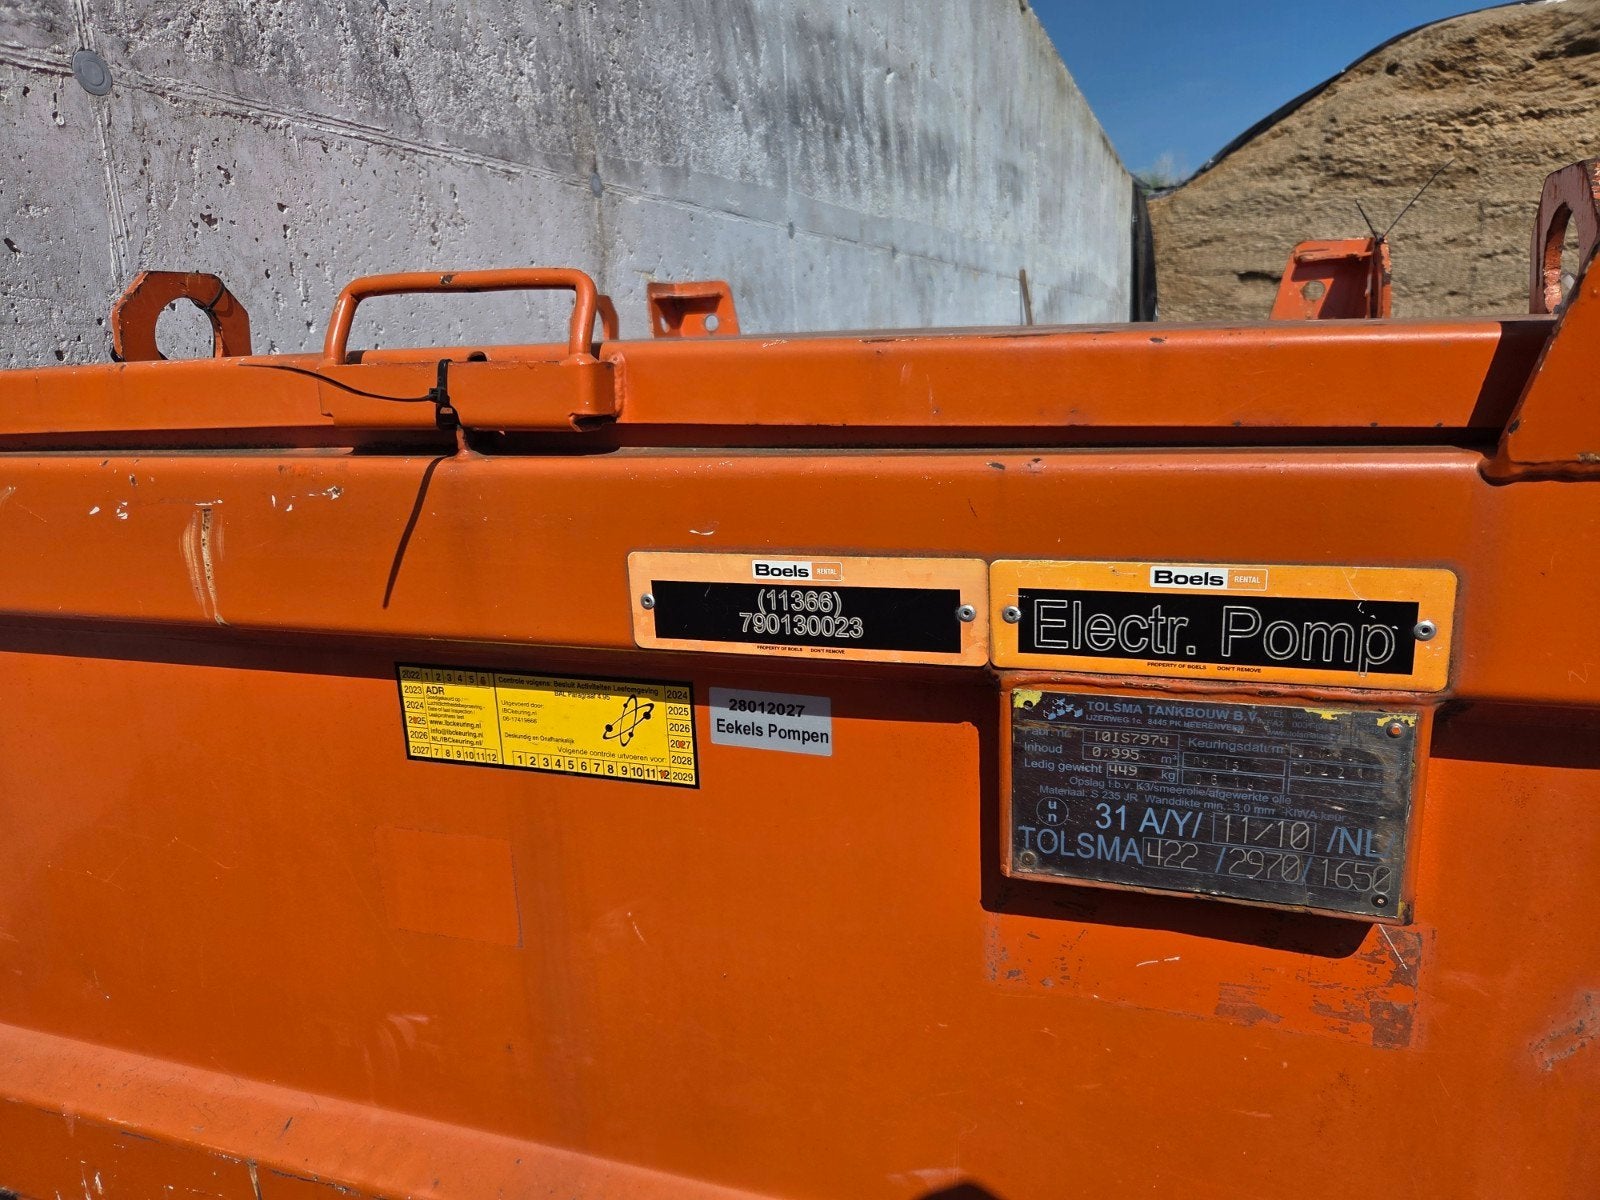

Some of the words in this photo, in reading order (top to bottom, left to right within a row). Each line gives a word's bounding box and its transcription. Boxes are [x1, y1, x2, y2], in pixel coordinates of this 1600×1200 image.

[755, 564, 809, 578] Boels
[1154, 570, 1224, 586] Boels
[1234, 575, 1260, 584] RENTAL
[758, 589, 842, 618] (11366)
[739, 612, 864, 638] 790130023
[1034, 599, 1196, 655] Electr.
[1222, 606, 1395, 677] Pomp
[402, 670, 421, 679] 2022
[436, 673, 441, 681] 2
[447, 674, 452, 682] 3
[404, 685, 422, 694] 2023
[426, 686, 444, 695] ADR
[667, 690, 687, 699] 2024
[406, 701, 424, 709] 2024
[668, 706, 689, 716] 2025
[729, 698, 805, 717] 28012027
[1087, 701, 1142, 714] TOLSMA
[1147, 705, 1229, 719] TANKBOUW
[1086, 715, 1129, 724] IJZERWEG
[410, 730, 428, 739] 2026
[669, 723, 690, 733] 2026
[716, 718, 764, 737] Eekels
[768, 723, 829, 745] Pompen
[412, 746, 430, 754] 2027
[476, 752, 485, 760] 11
[487, 753, 496, 761] 12
[557, 746, 587, 755] Volgende
[589, 750, 615, 758] controle
[618, 753, 648, 761] uitvoeren
[1025, 742, 1062, 754] Inhoud
[518, 755, 522, 764] 1
[529, 756, 536, 766] 2
[542, 757, 549, 767] 3
[555, 759, 561, 768] 4
[567, 760, 574, 770] 5
[580, 761, 587, 771] 6
[593, 763, 600, 772] 7
[607, 764, 614, 774] 8
[621, 765, 627, 775] 9
[632, 767, 643, 777] 10
[645, 768, 656, 778] 11
[671, 755, 692, 766] 2028
[1025, 759, 1054, 771] Ledig
[1058, 762, 1102, 773] gewicht
[673, 771, 693, 781] 2029
[1109, 764, 1137, 776] 449
[1162, 770, 1175, 782] kg
[1070, 776, 1104, 788] Opslag
[1272, 795, 1292, 804] olie
[1091, 790, 1098, 798] S
[1101, 790, 1120, 800] 235
[1124, 793, 1138, 801] JR
[1144, 794, 1200, 808] Wanddikte
[1254, 806, 1275, 815] mm
[1095, 802, 1127, 831] 31
[1139, 807, 1203, 838] A/Y/
[1224, 814, 1310, 850] 11/10
[1018, 825, 1143, 865] TOLSMA
[1147, 838, 1198, 870] 422
[1322, 858, 1392, 894] 1650
